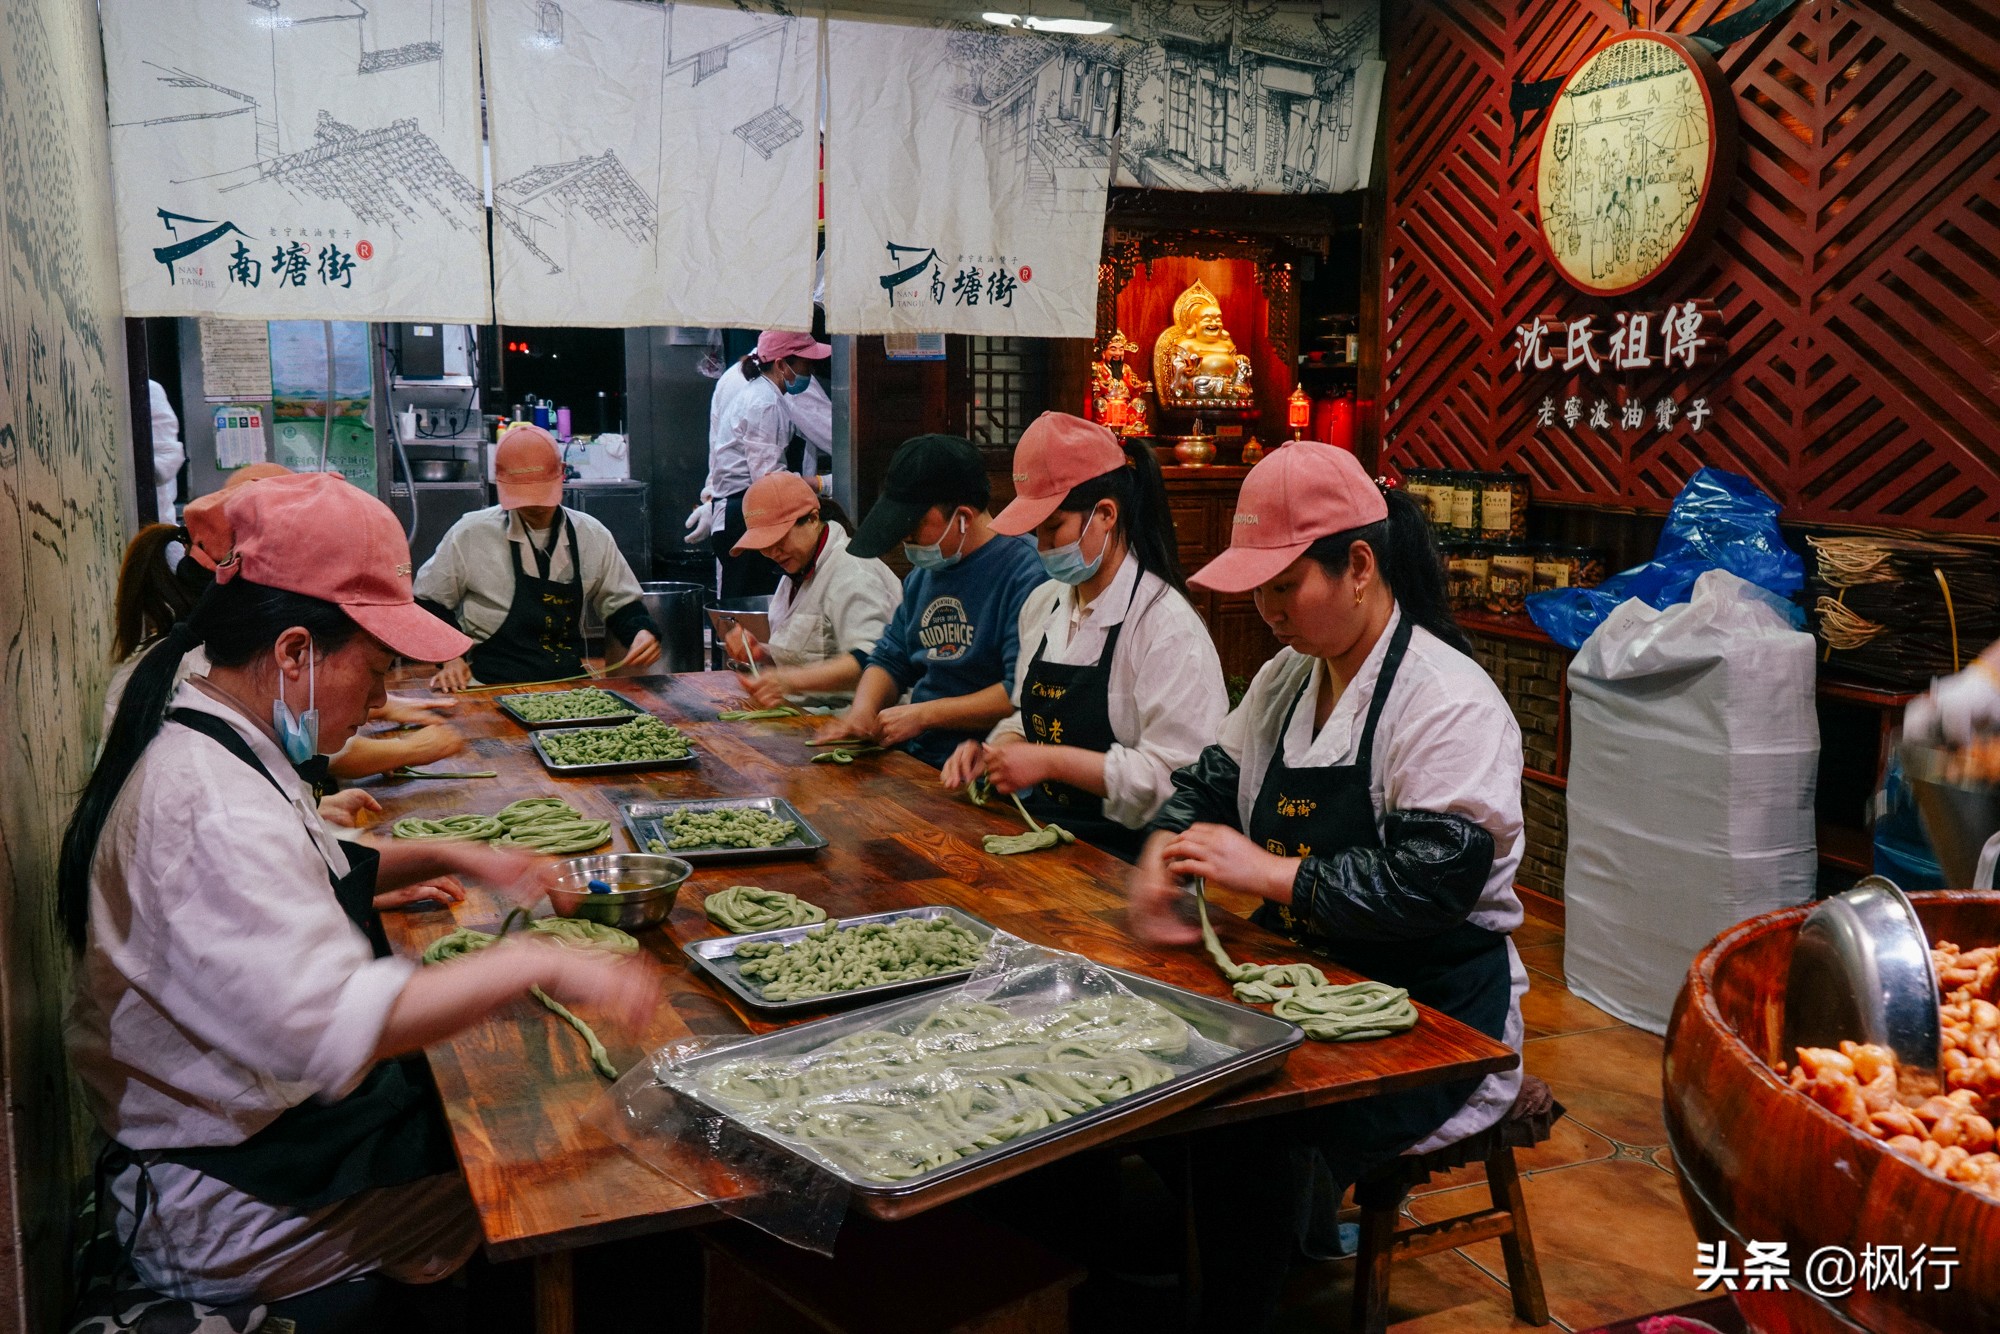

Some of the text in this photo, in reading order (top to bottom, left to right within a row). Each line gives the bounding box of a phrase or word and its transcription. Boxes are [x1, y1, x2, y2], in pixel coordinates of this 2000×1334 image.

[227, 239, 358, 289] 南塘街
[930, 263, 1018, 308] 南塘街
[1514, 301, 1706, 373] 沈氏祖傳
[918, 623, 974, 649] AUDIENCE
